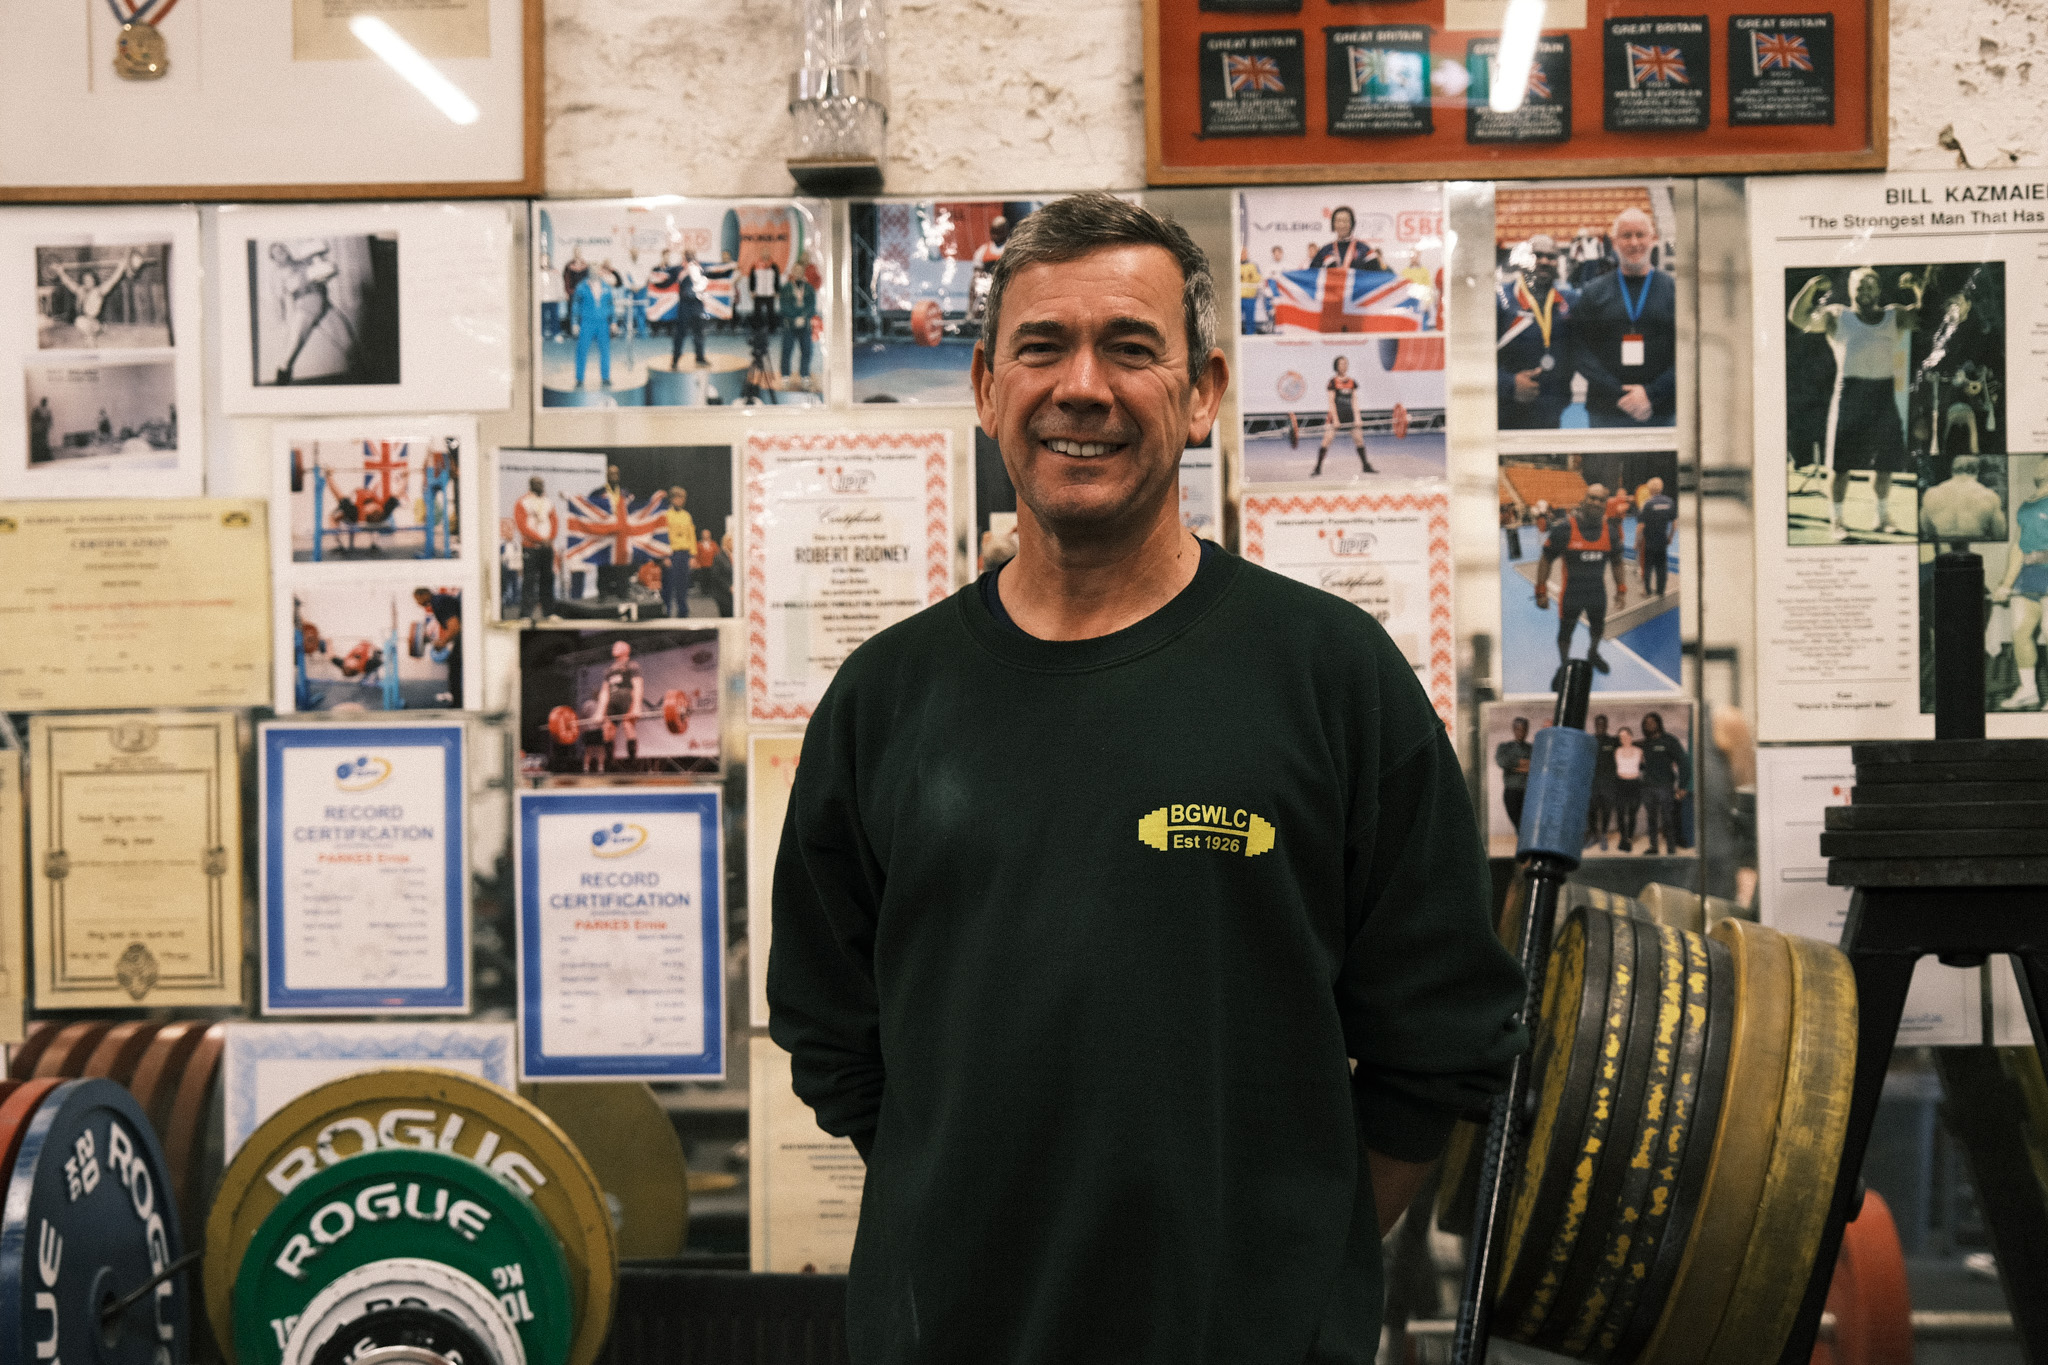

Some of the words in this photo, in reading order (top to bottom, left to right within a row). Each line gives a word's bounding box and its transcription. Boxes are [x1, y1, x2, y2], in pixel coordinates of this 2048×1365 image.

[1611, 24, 1652, 36] GREAT
[1655, 22, 1703, 33] BRITAIN
[1736, 18, 1776, 29] GREAT
[1779, 17, 1827, 28] BRITAIN
[1207, 38, 1247, 50] GREAT
[1251, 36, 1297, 48] BRITAIN
[1333, 31, 1373, 43] GREAT
[1376, 30, 1424, 42] BRITAIN
[1886, 187, 1933, 204] BILL
[1945, 183, 2048, 203] KAZMAIE
[1843, 212, 1925, 229] Strongest
[1930, 211, 1965, 226] Man
[1970, 209, 2007, 224] That
[2013, 208, 2045, 223] Has
[794, 546, 849, 563] ROBERT
[853, 545, 910, 563] RODNEY
[324, 804, 404, 821] RECORD
[1170, 803, 1248, 828] BGWLC
[293, 825, 434, 843] CERTIFICATION
[1173, 834, 1201, 849] Est
[1204, 835, 1241, 853] 1926
[317, 853, 374, 864] PARKES
[580, 871, 660, 888] RECORD
[550, 892, 691, 909] CERTIFICATION
[574, 919, 630, 931] PARKES
[633, 920, 667, 930] Ernie
[265, 1108, 548, 1197] ROGUE
[274, 1181, 492, 1279] ROGUE
